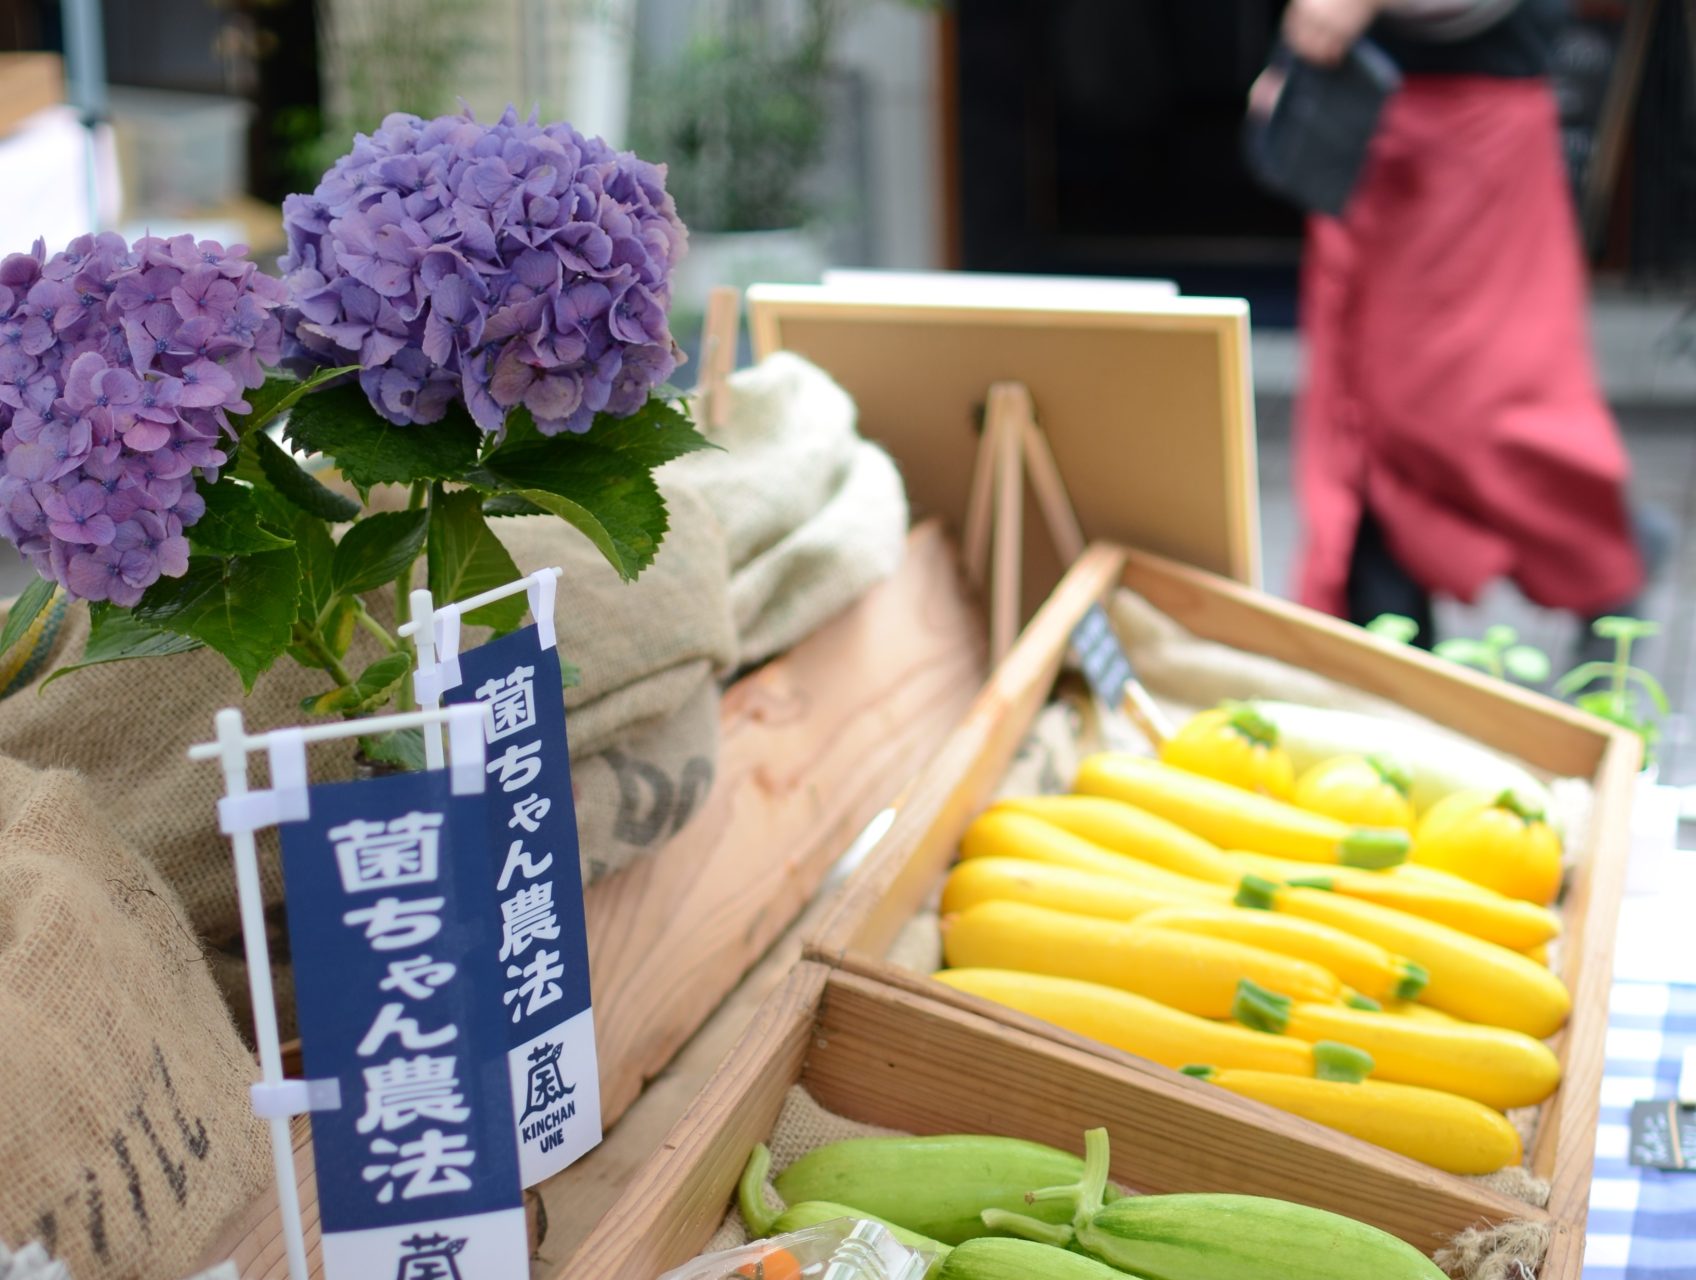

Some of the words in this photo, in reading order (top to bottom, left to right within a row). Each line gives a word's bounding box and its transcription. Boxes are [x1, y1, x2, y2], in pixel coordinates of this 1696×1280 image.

[475, 665, 565, 1025] 菌ちゃん農法
[329, 811, 475, 1203] 菌ちゃん農法
[522, 1100, 576, 1144] KINCHAN
[540, 1128, 565, 1154] UNE
